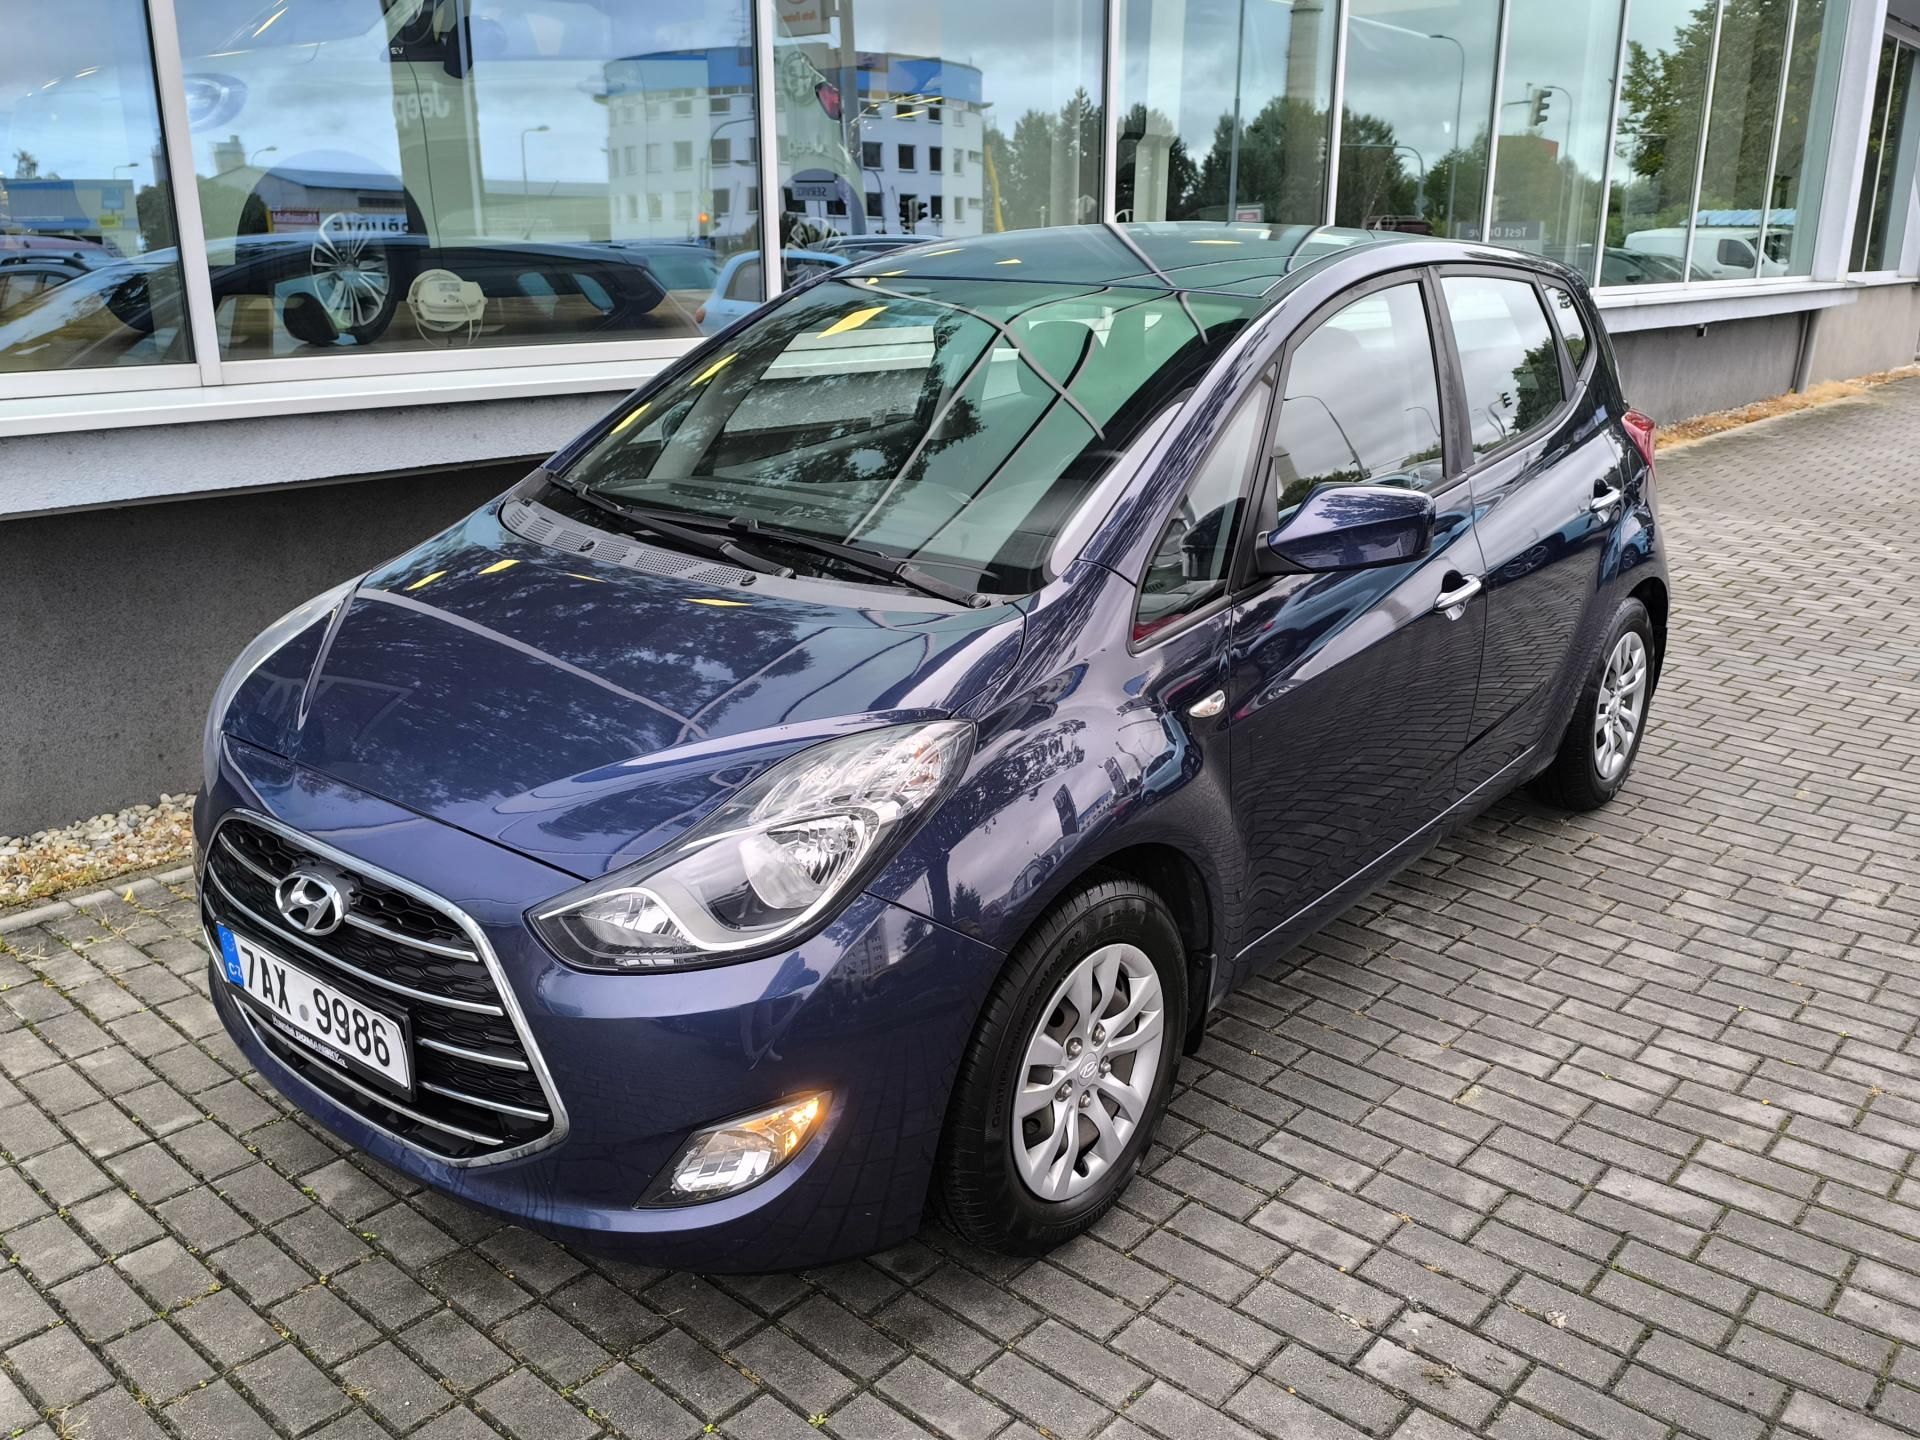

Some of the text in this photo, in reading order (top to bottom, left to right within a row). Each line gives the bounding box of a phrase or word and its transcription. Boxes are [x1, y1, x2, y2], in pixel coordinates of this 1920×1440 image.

[229, 962, 243, 978] CZ
[241, 945, 390, 1067] 7AX 9986
